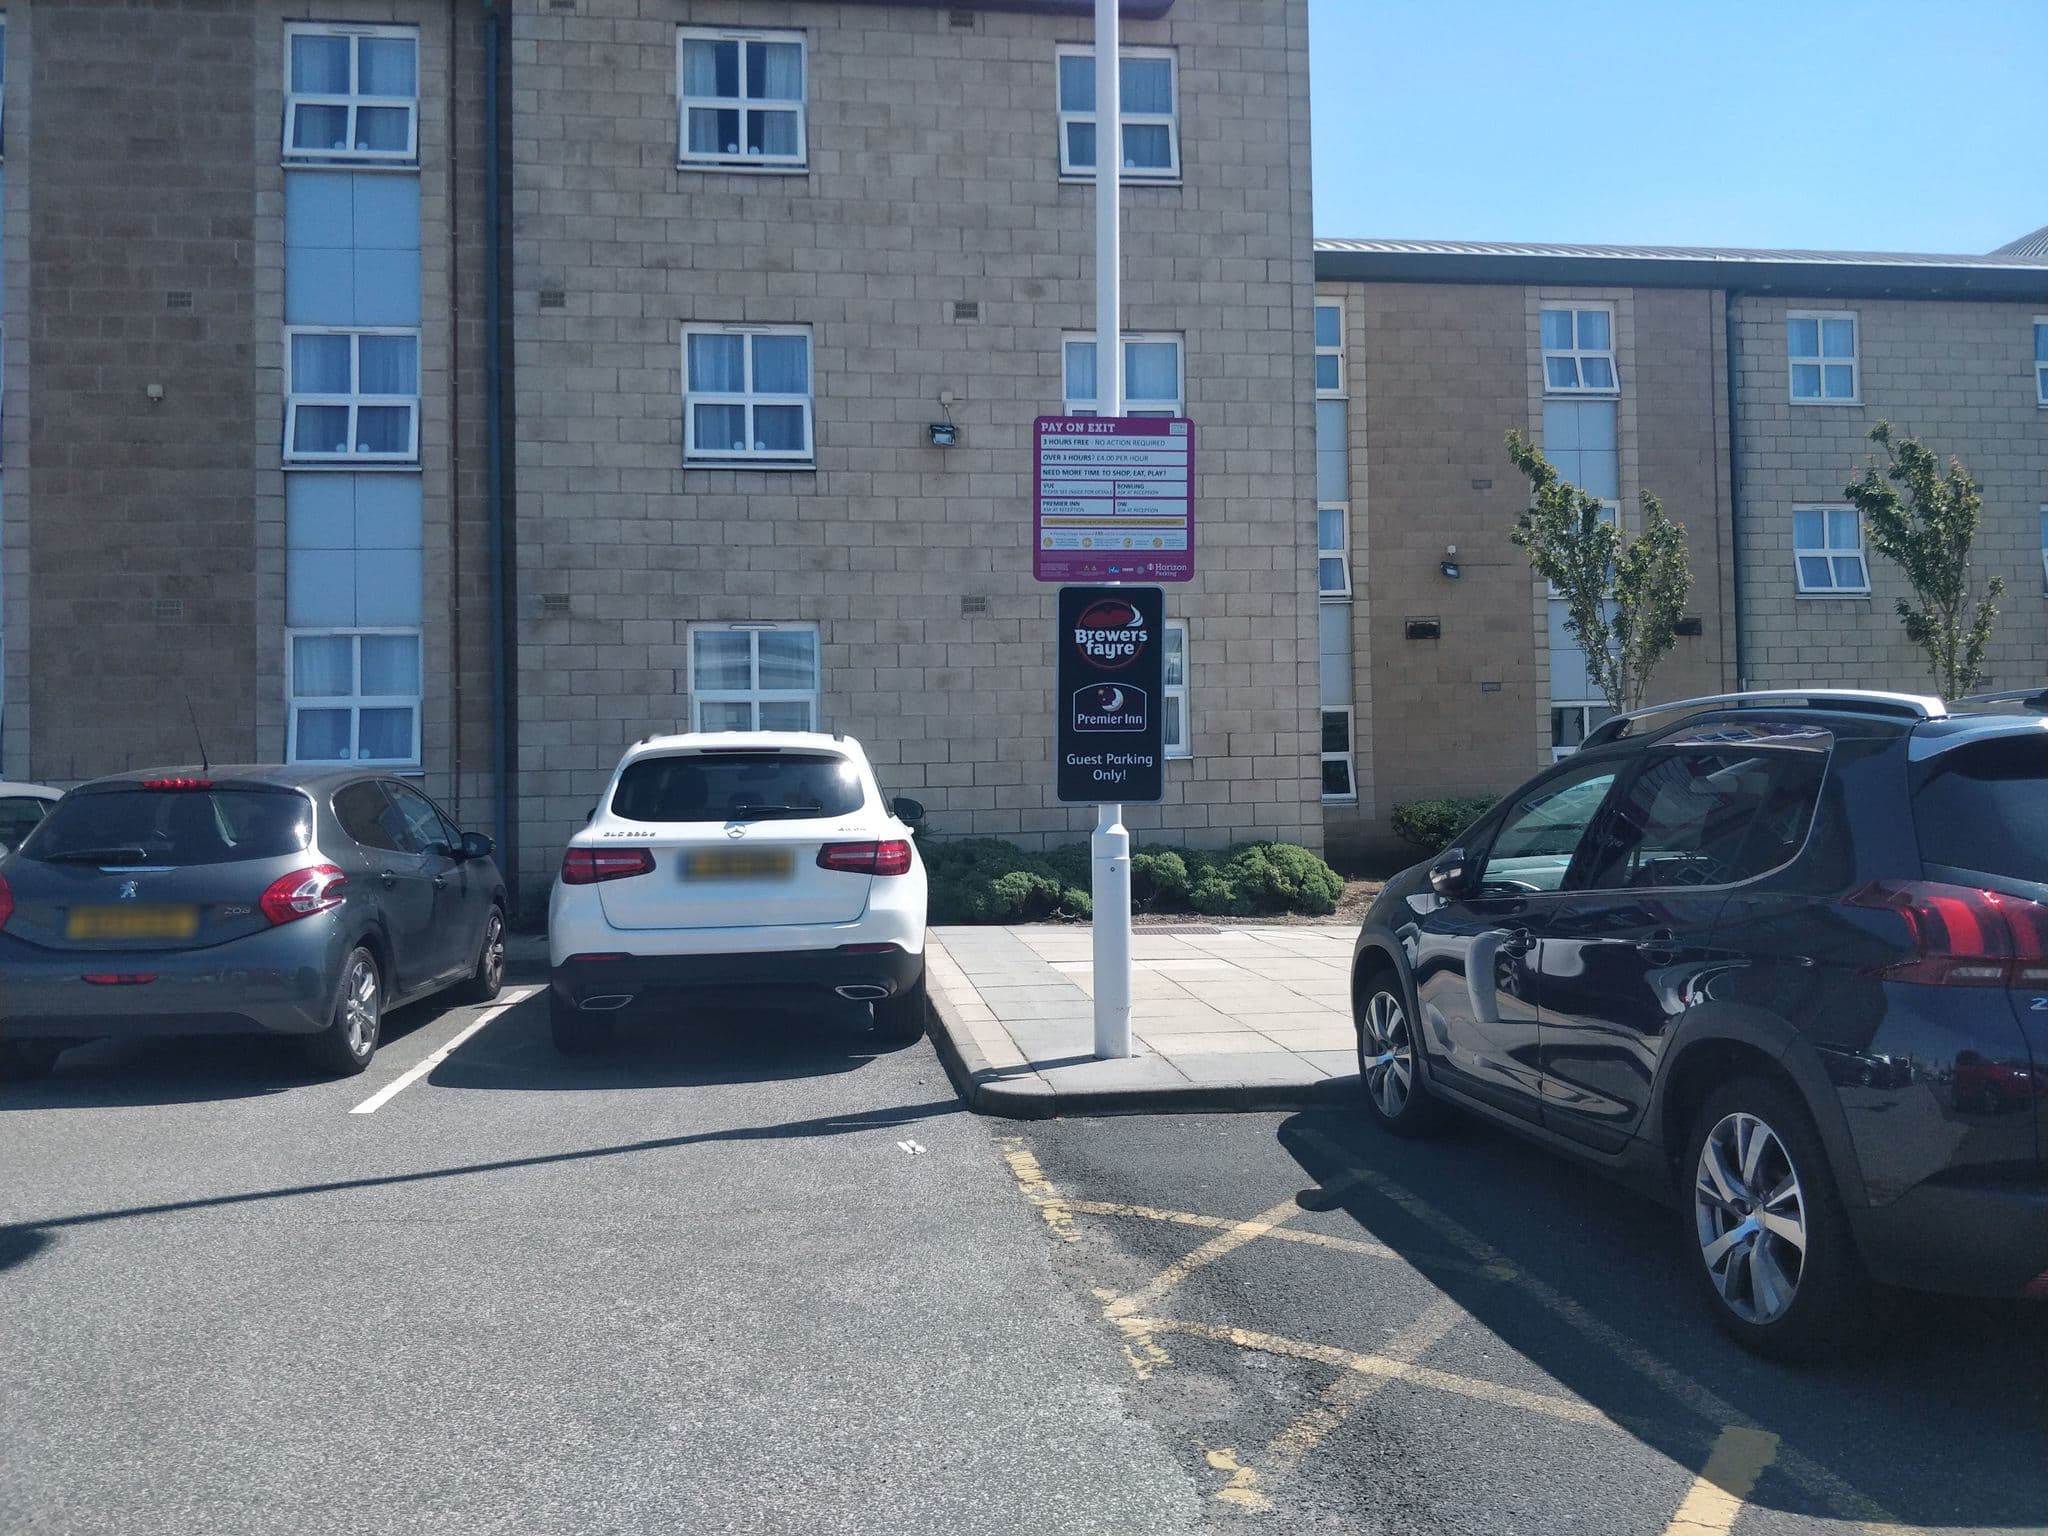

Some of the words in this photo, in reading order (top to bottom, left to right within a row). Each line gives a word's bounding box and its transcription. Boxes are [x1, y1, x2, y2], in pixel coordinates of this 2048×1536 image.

[1041, 422, 1063, 432] PAY
[1066, 423, 1085, 432] ON
[1088, 423, 1116, 433] EXIT
[1107, 439, 1131, 447] ACTION
[1043, 469, 1061, 477] NEED
[1062, 469, 1082, 477] MORE
[1112, 470, 1132, 478] SHOP,
[1155, 563, 1187, 571] Horizon
[1075, 629, 1148, 644] Brewers
[1086, 640, 1135, 659] fayre
[1077, 713, 1123, 725] Premier
[1125, 714, 1143, 725] Inn
[1066, 753, 1103, 765] Guest
[1106, 753, 1153, 768] Parking
[1092, 769, 1127, 783] Only!
